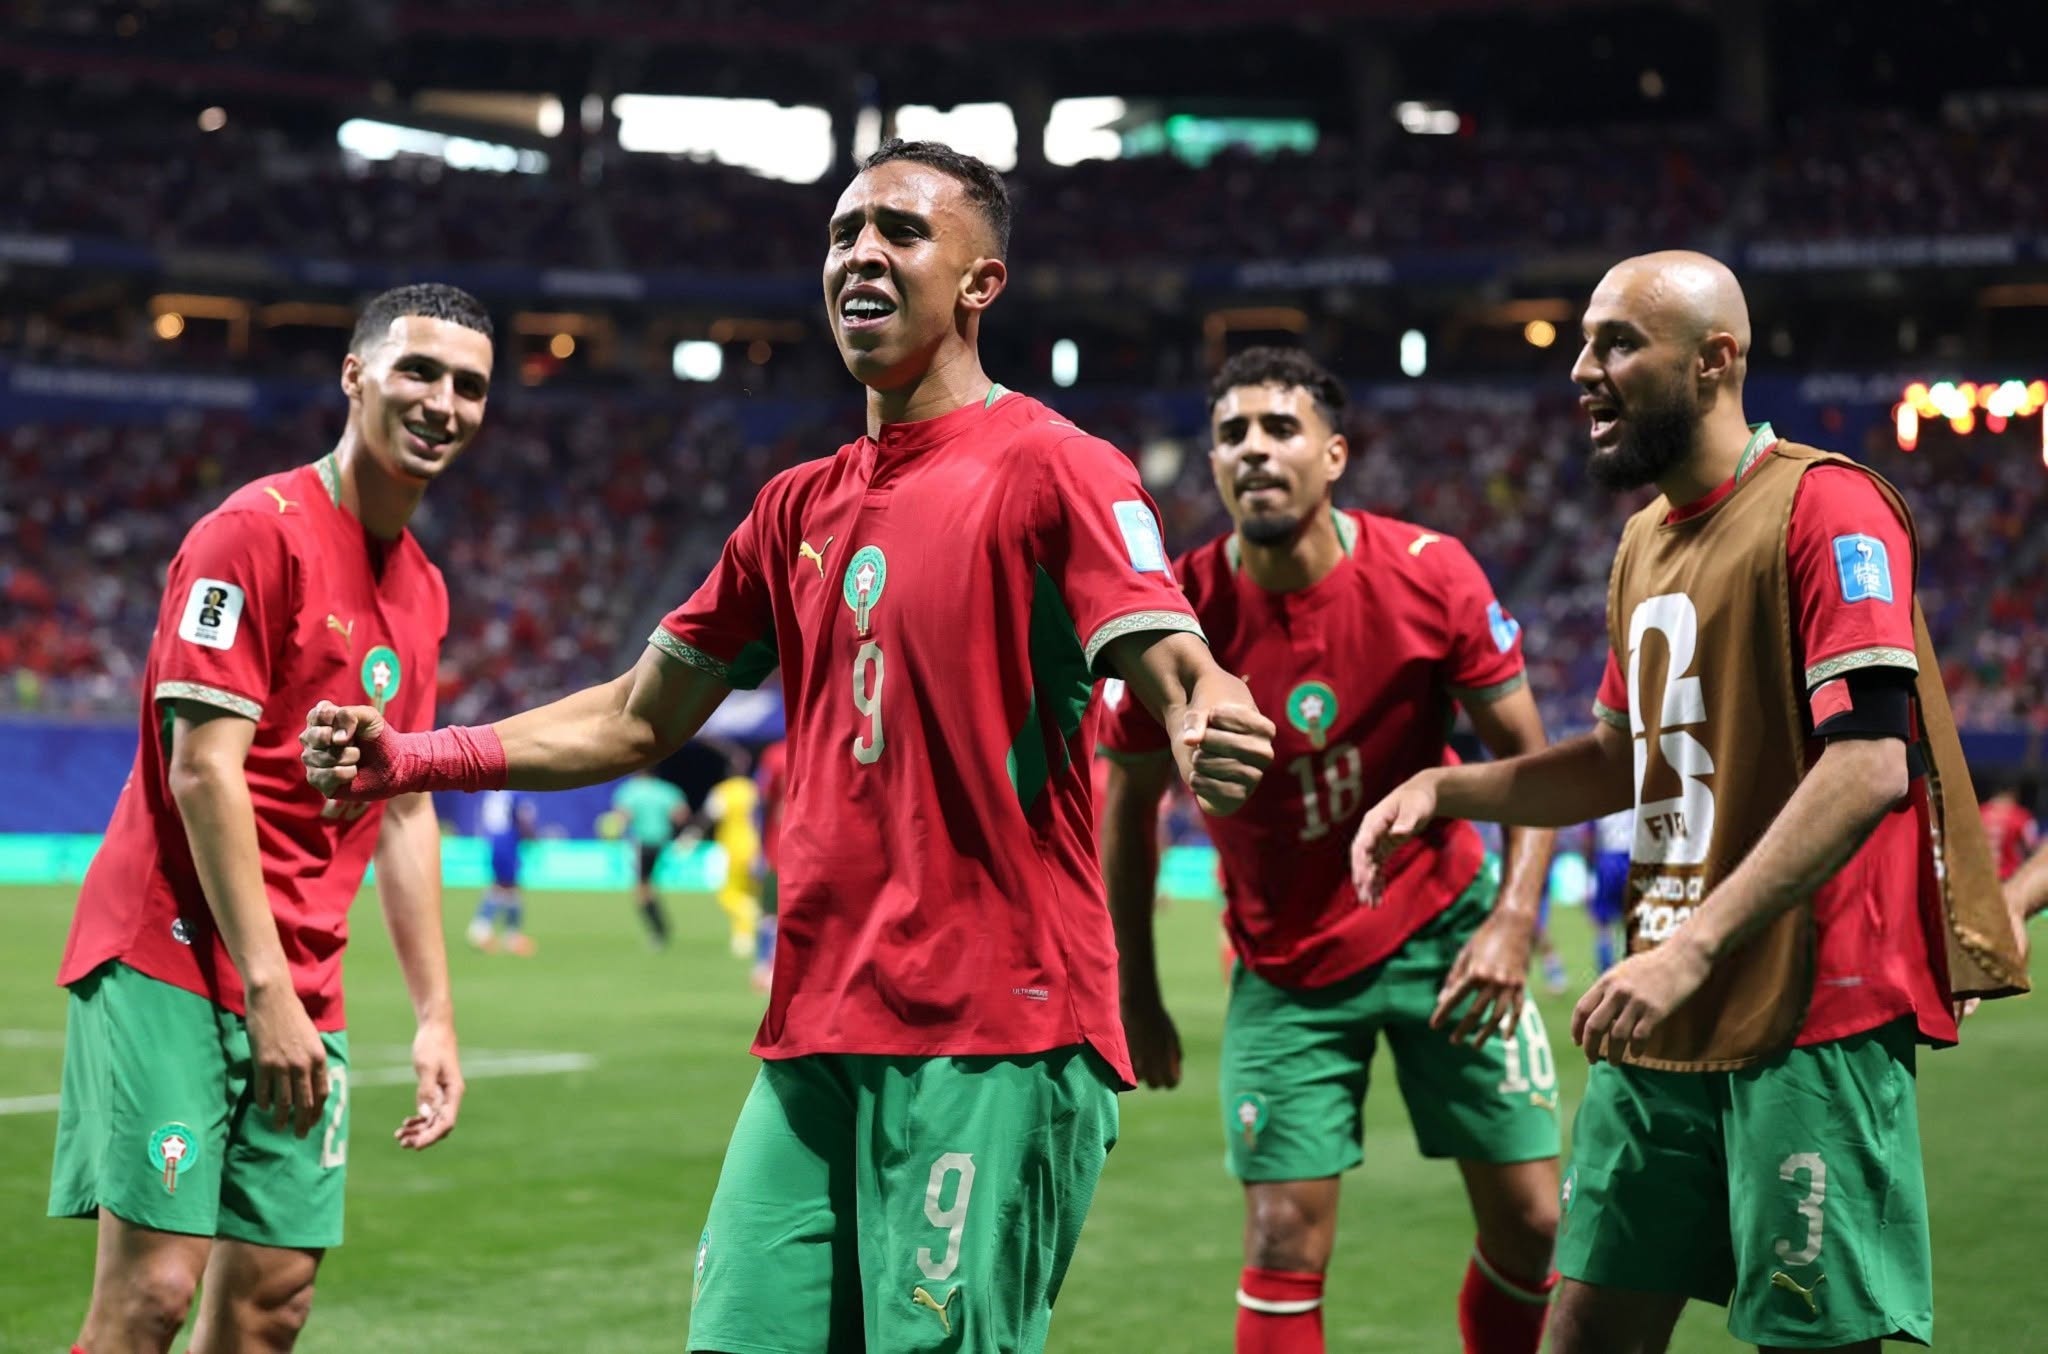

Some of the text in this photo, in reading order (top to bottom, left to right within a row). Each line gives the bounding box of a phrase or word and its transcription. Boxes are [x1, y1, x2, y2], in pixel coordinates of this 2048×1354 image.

[853, 640, 885, 764] 9
[1288, 744, 1362, 840] 18
[1498, 1001, 1556, 1093] 18
[916, 1152, 977, 1281] 9
[1775, 1152, 1827, 1266] 3
